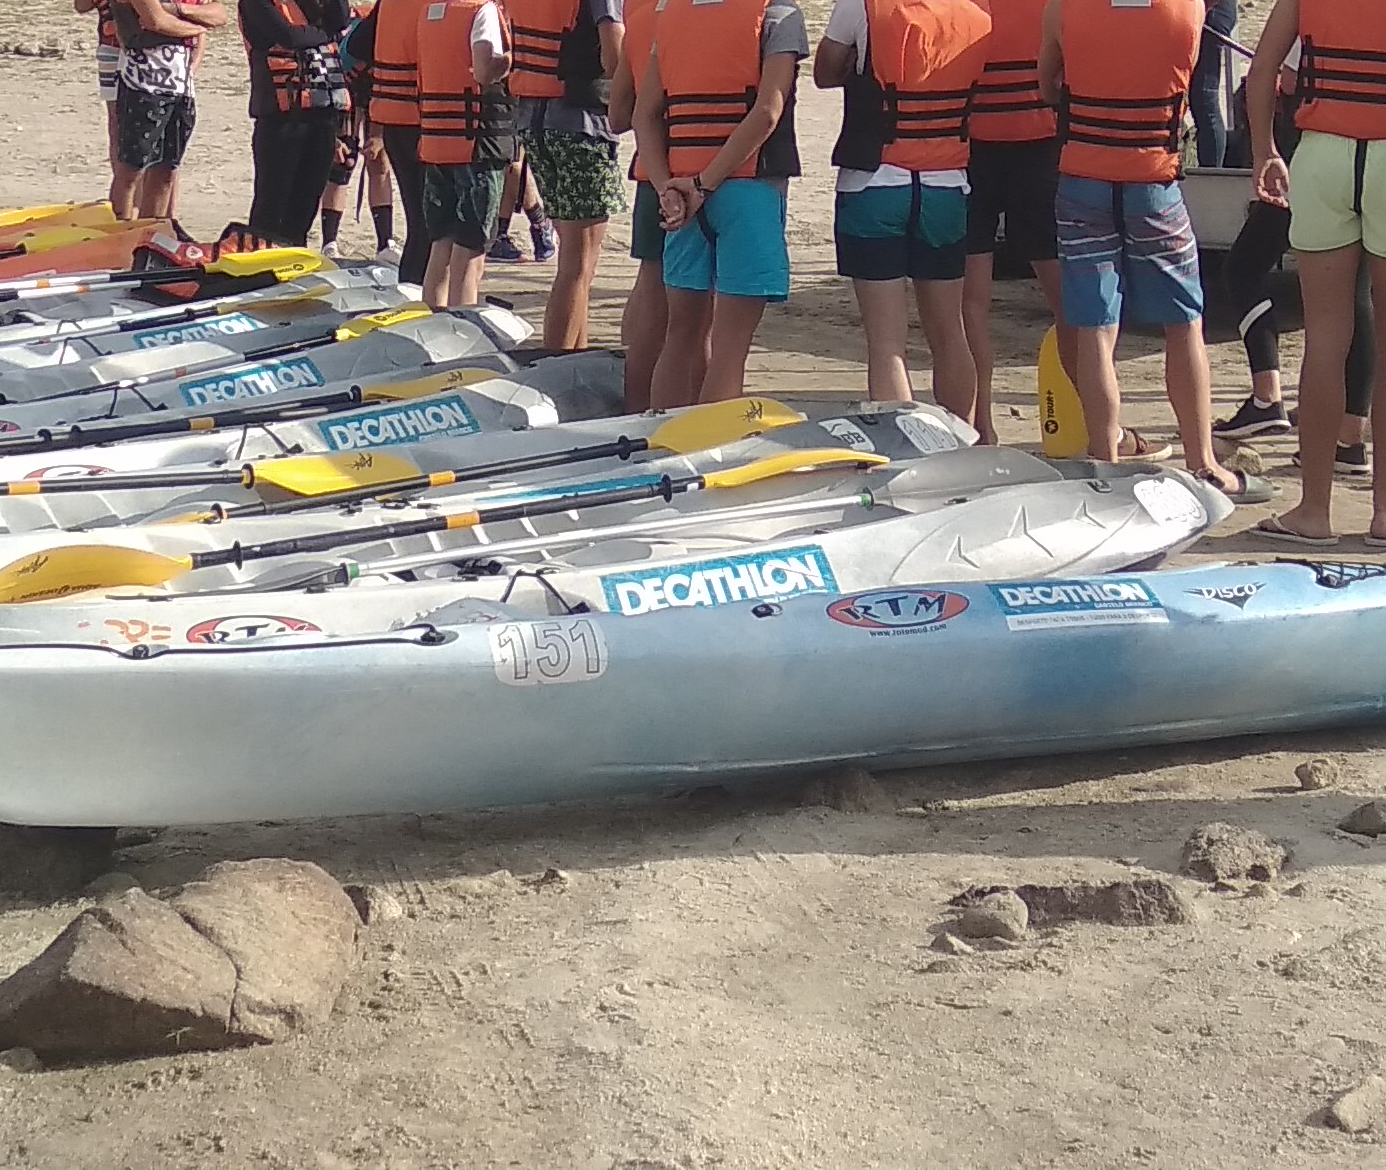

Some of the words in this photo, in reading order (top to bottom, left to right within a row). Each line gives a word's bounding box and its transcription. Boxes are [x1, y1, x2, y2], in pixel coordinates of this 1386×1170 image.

[188, 359, 319, 407] DECATHLON
[328, 401, 470, 451] DECATHLON
[615, 553, 826, 616] DECATHLON
[838, 592, 948, 621] RTM
[999, 582, 1150, 607] DECATHLON
[1202, 583, 1258, 600] DISCO
[497, 618, 602, 680] 151
